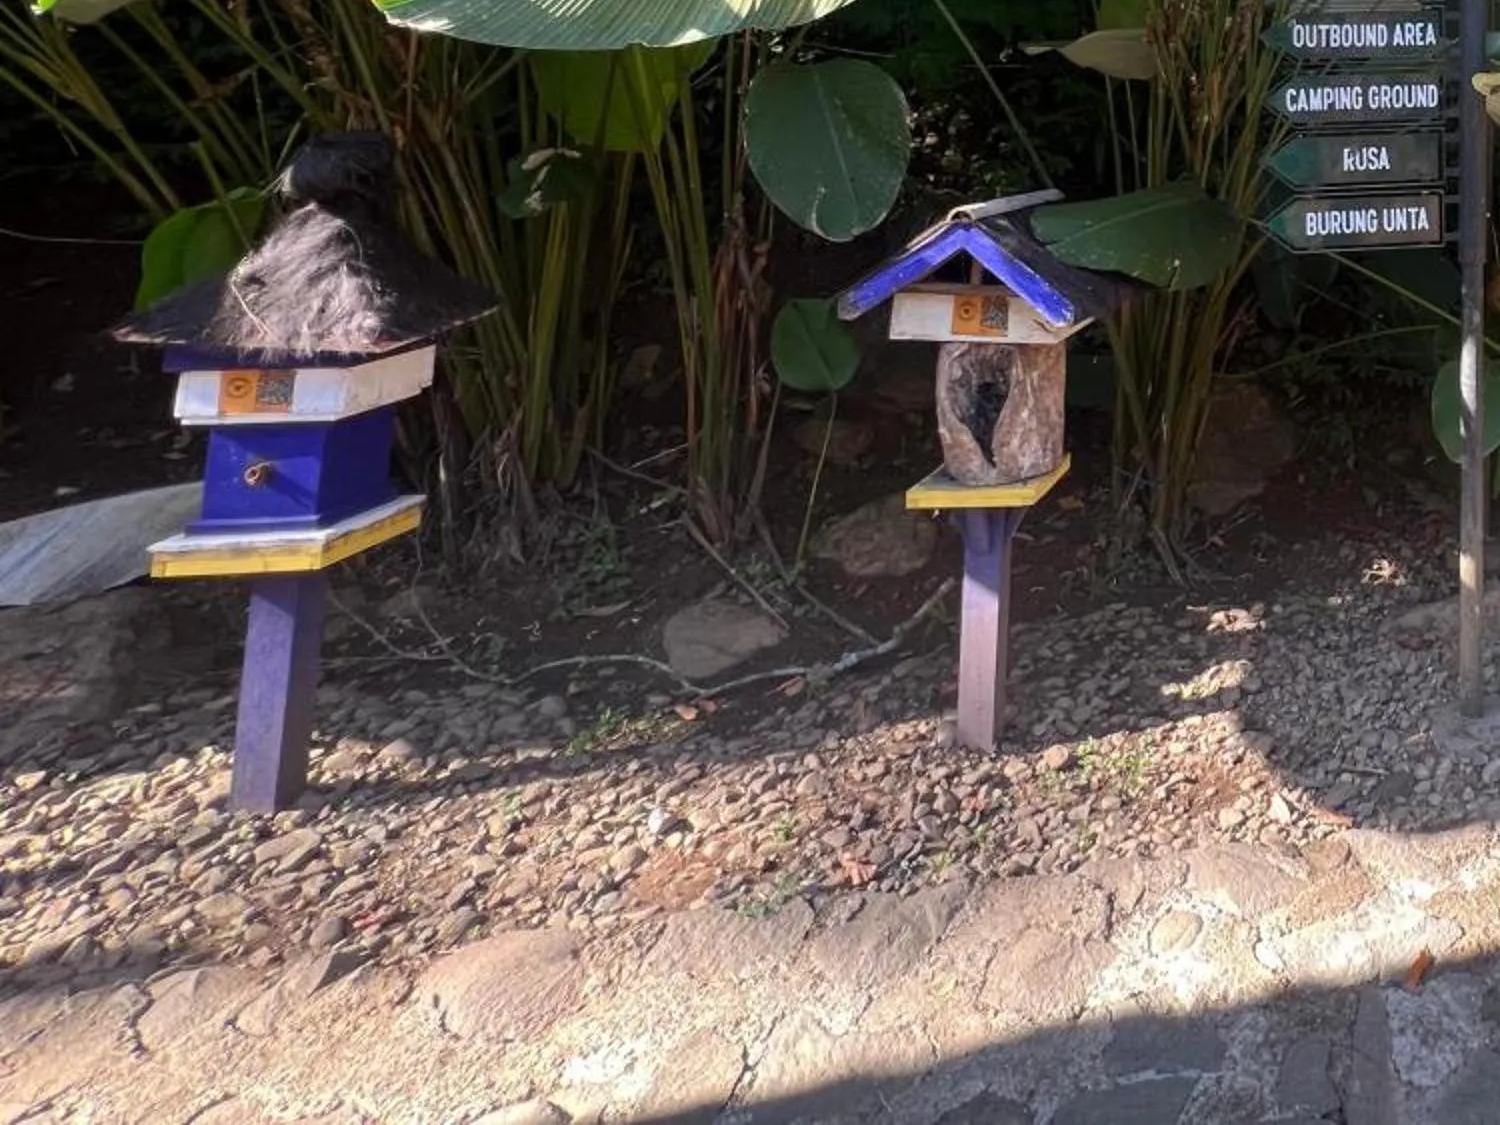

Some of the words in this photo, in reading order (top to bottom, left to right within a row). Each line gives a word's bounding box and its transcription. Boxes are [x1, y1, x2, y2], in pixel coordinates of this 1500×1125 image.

[1292, 24, 1388, 48] OUTBOUND
[1393, 23, 1437, 46] AREA
[1285, 86, 1363, 112] CAMPING
[1368, 84, 1439, 109] GROUND
[1343, 147, 1390, 171] RUSA
[1306, 209, 1378, 236] BURUNG
[1383, 207, 1429, 232] UNTA
